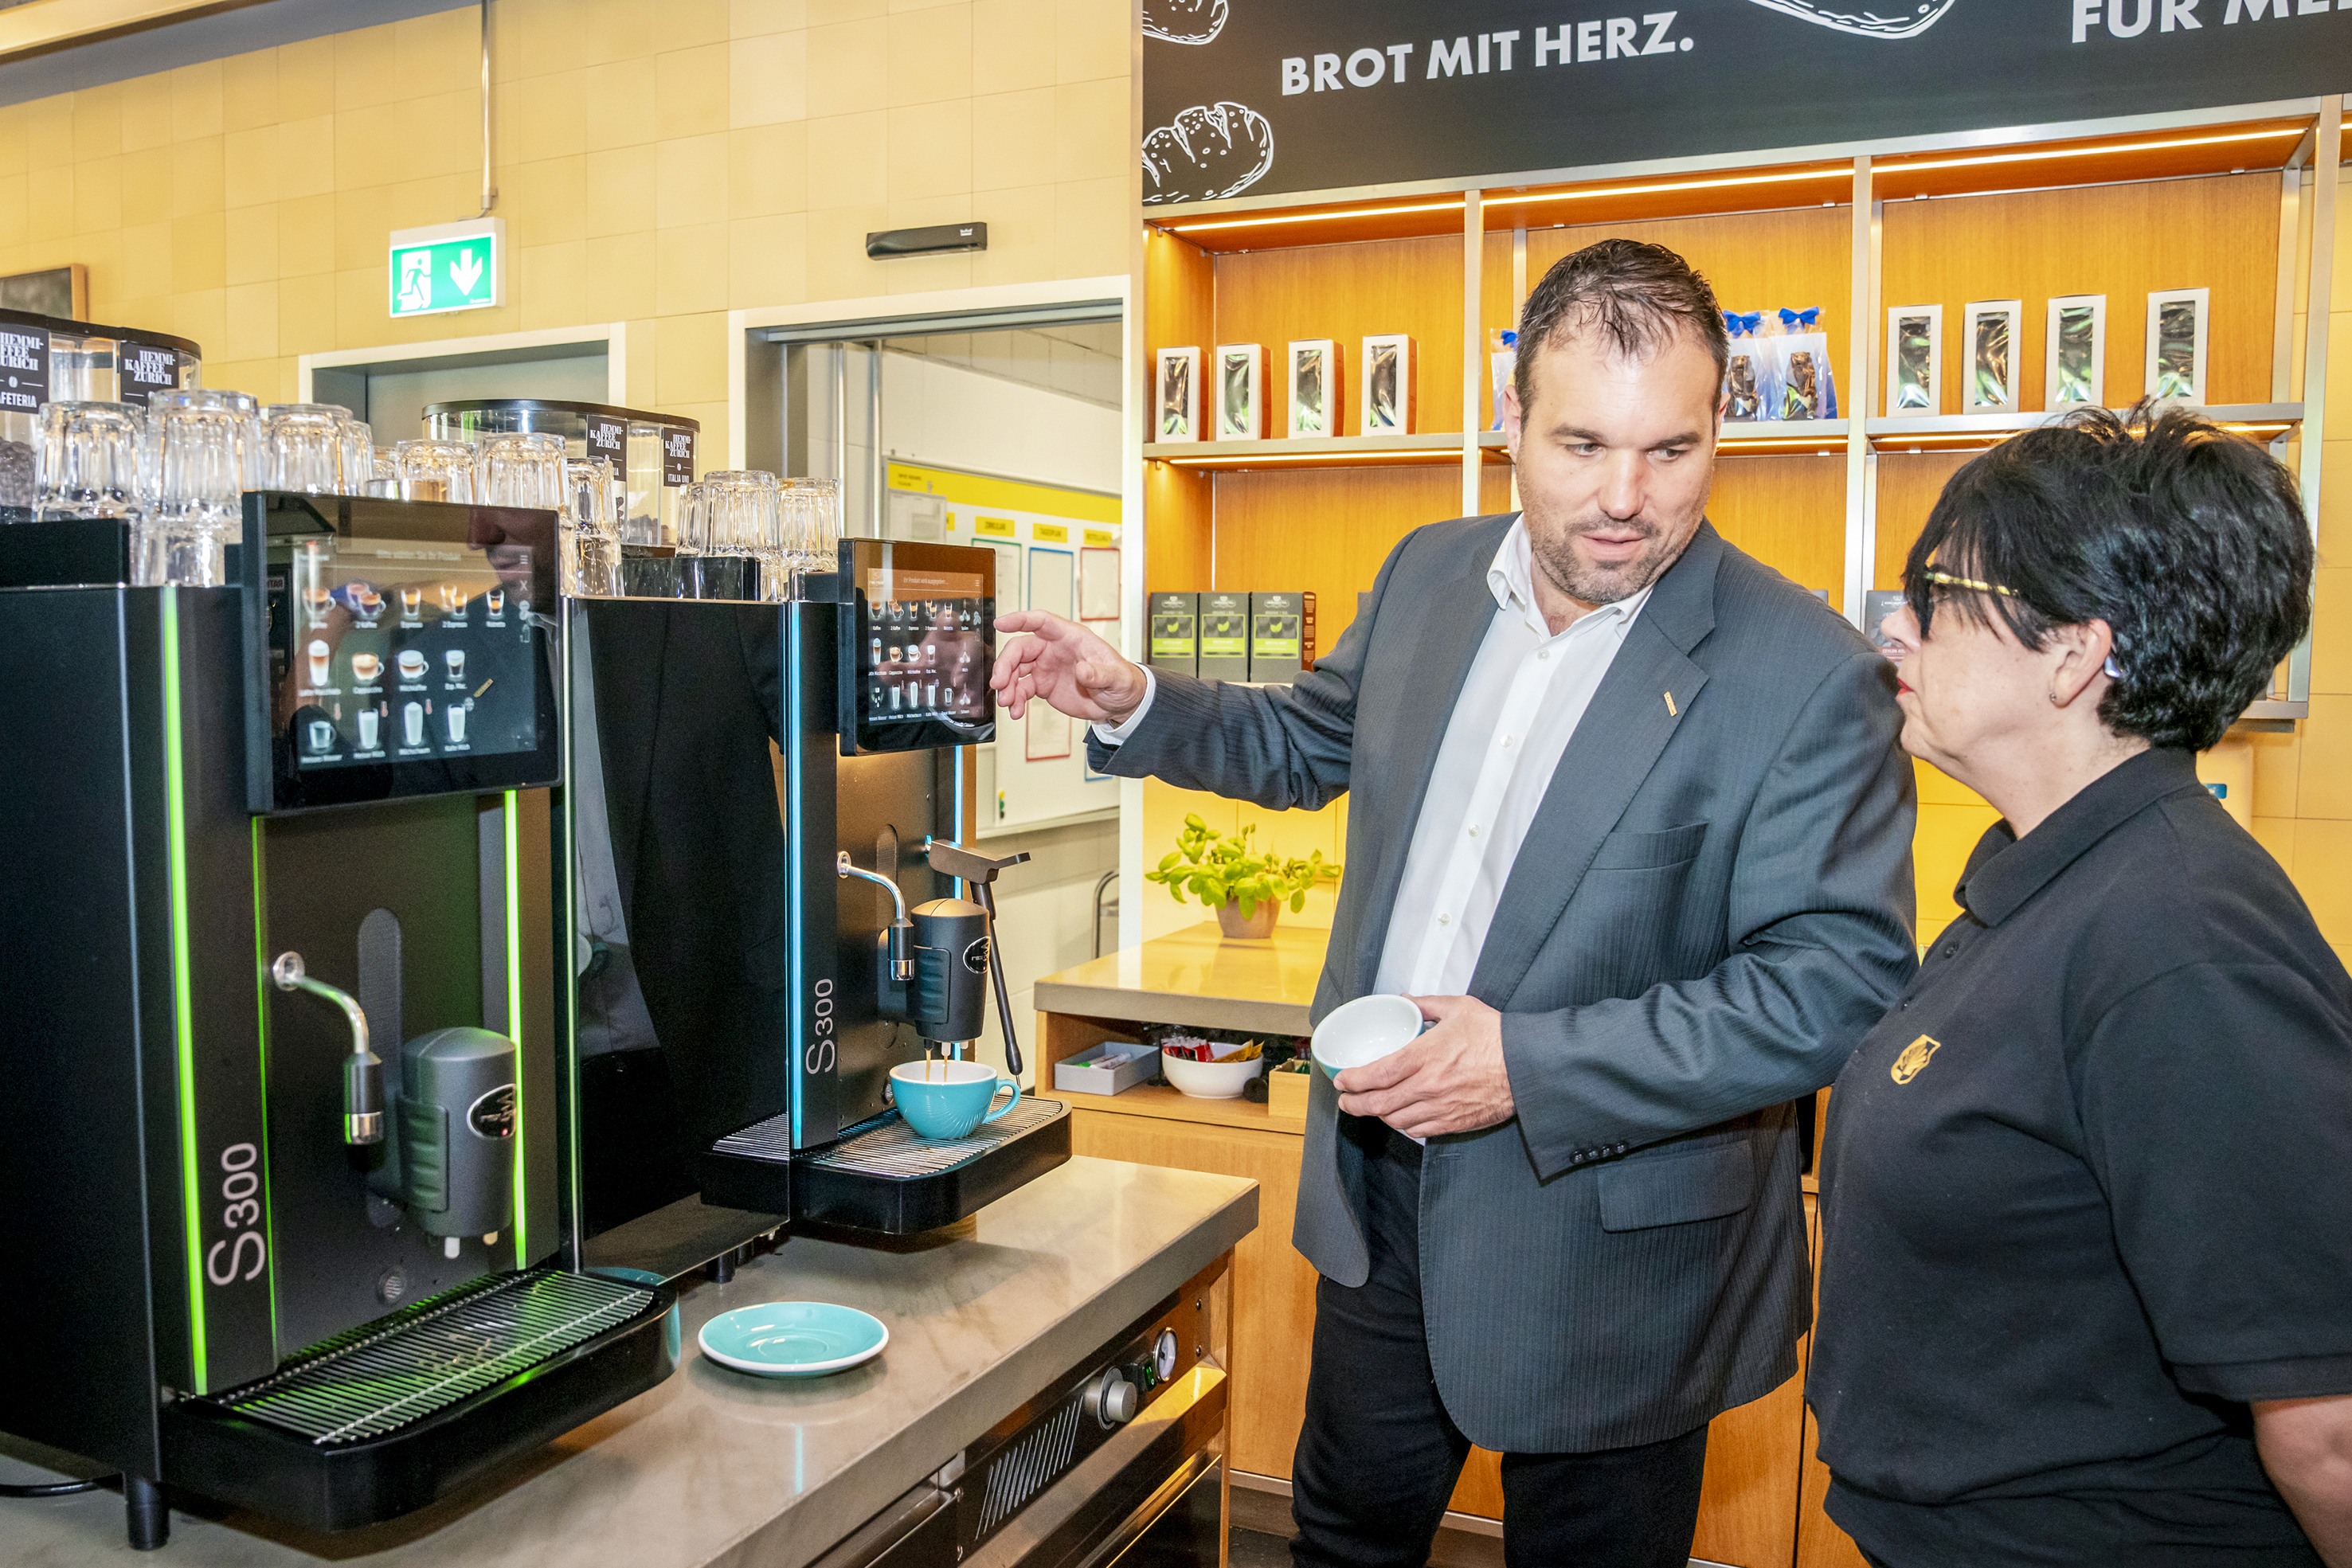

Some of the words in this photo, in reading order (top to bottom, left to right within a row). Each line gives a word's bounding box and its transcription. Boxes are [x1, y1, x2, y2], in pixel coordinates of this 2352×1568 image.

[1282, 43, 1413, 96] BROT
[1426, 30, 1520, 79] MIT
[1535, 11, 1694, 67] HERZ.
[0, 343, 29, 358] FFEE
[139, 350, 175, 366] HEMMI-
[0, 355, 38, 371] URICH
[124, 358, 165, 374] KAFFEE
[0, 392, 37, 408] FETERIA
[590, 429, 616, 441] KAFFEE
[601, 423, 623, 435] HEMMI-
[664, 440, 687, 452] KAFFEE
[673, 434, 691, 444] HEMMI-
[805, 979, 835, 1074] S300
[207, 1143, 265, 1285] S300
